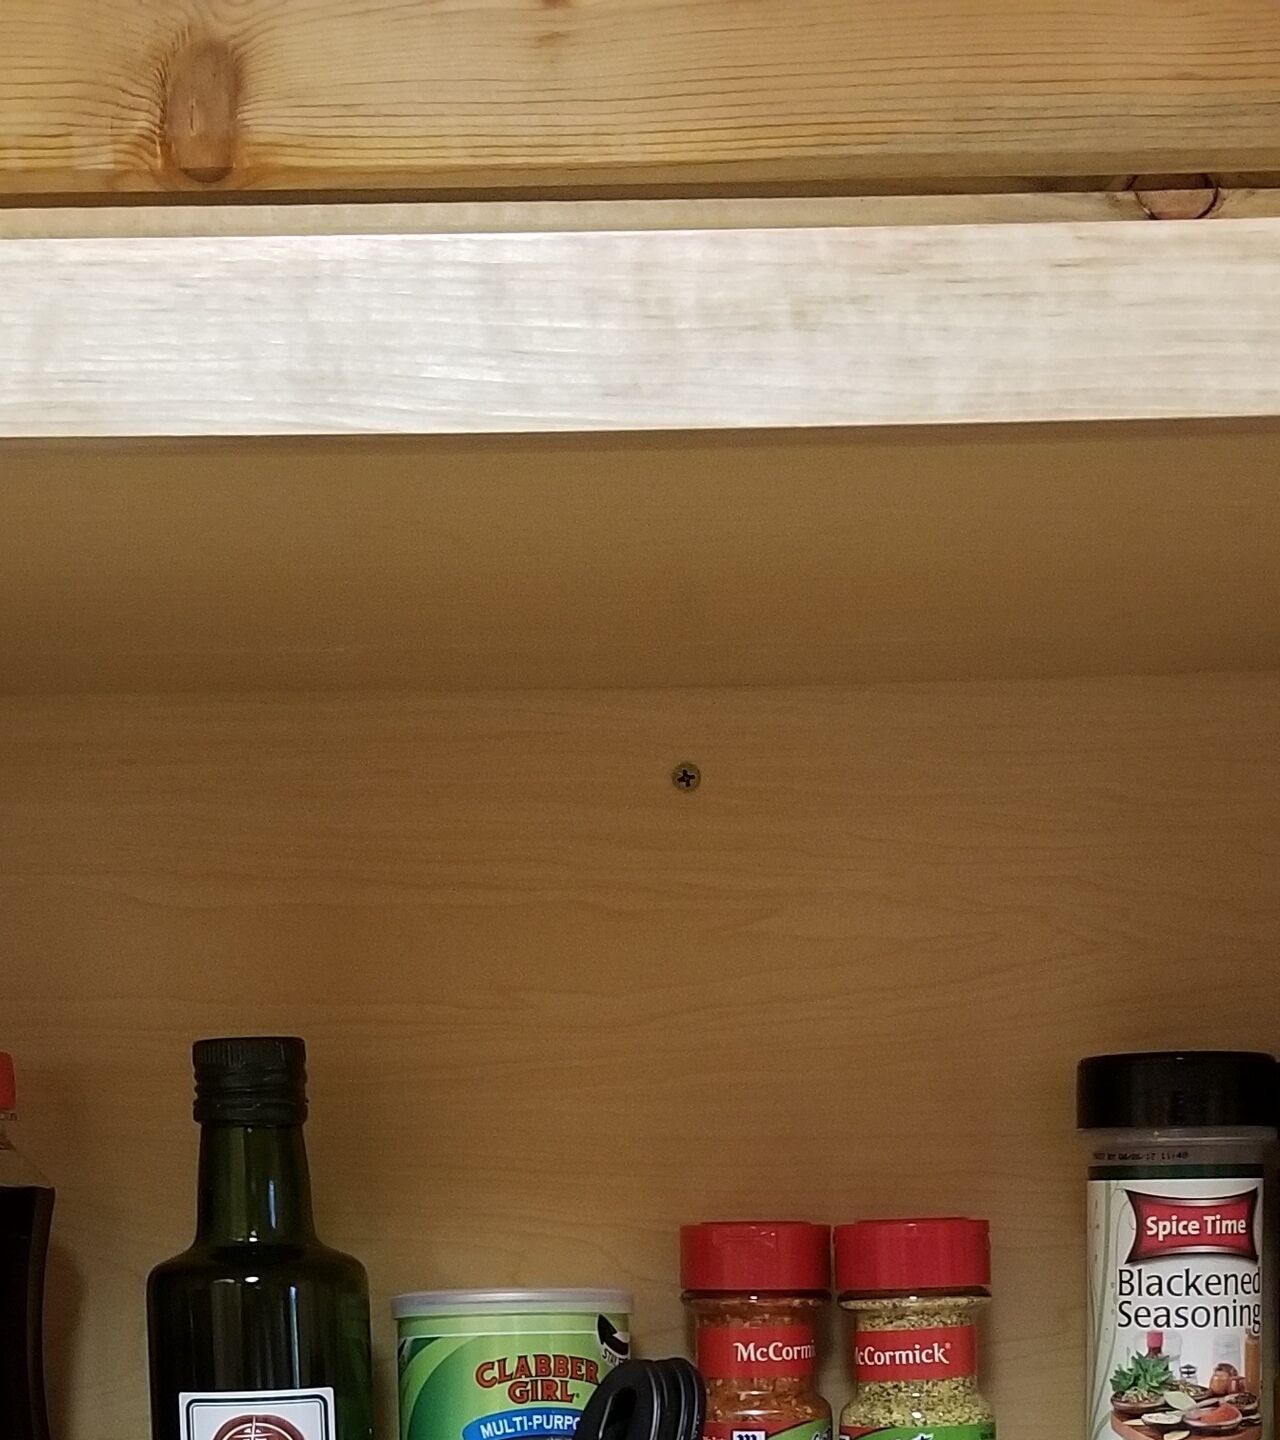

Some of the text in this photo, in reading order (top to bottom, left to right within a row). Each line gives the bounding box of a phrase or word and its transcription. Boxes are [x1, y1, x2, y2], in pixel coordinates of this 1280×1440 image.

[1146, 1214, 1246, 1242] Spice Time
[1118, 1268, 1261, 1297] Blackened
[1118, 1300, 1261, 1334] Seasoning
[476, 1354, 601, 1388] CLABBER
[508, 1379, 575, 1404] GIRL
